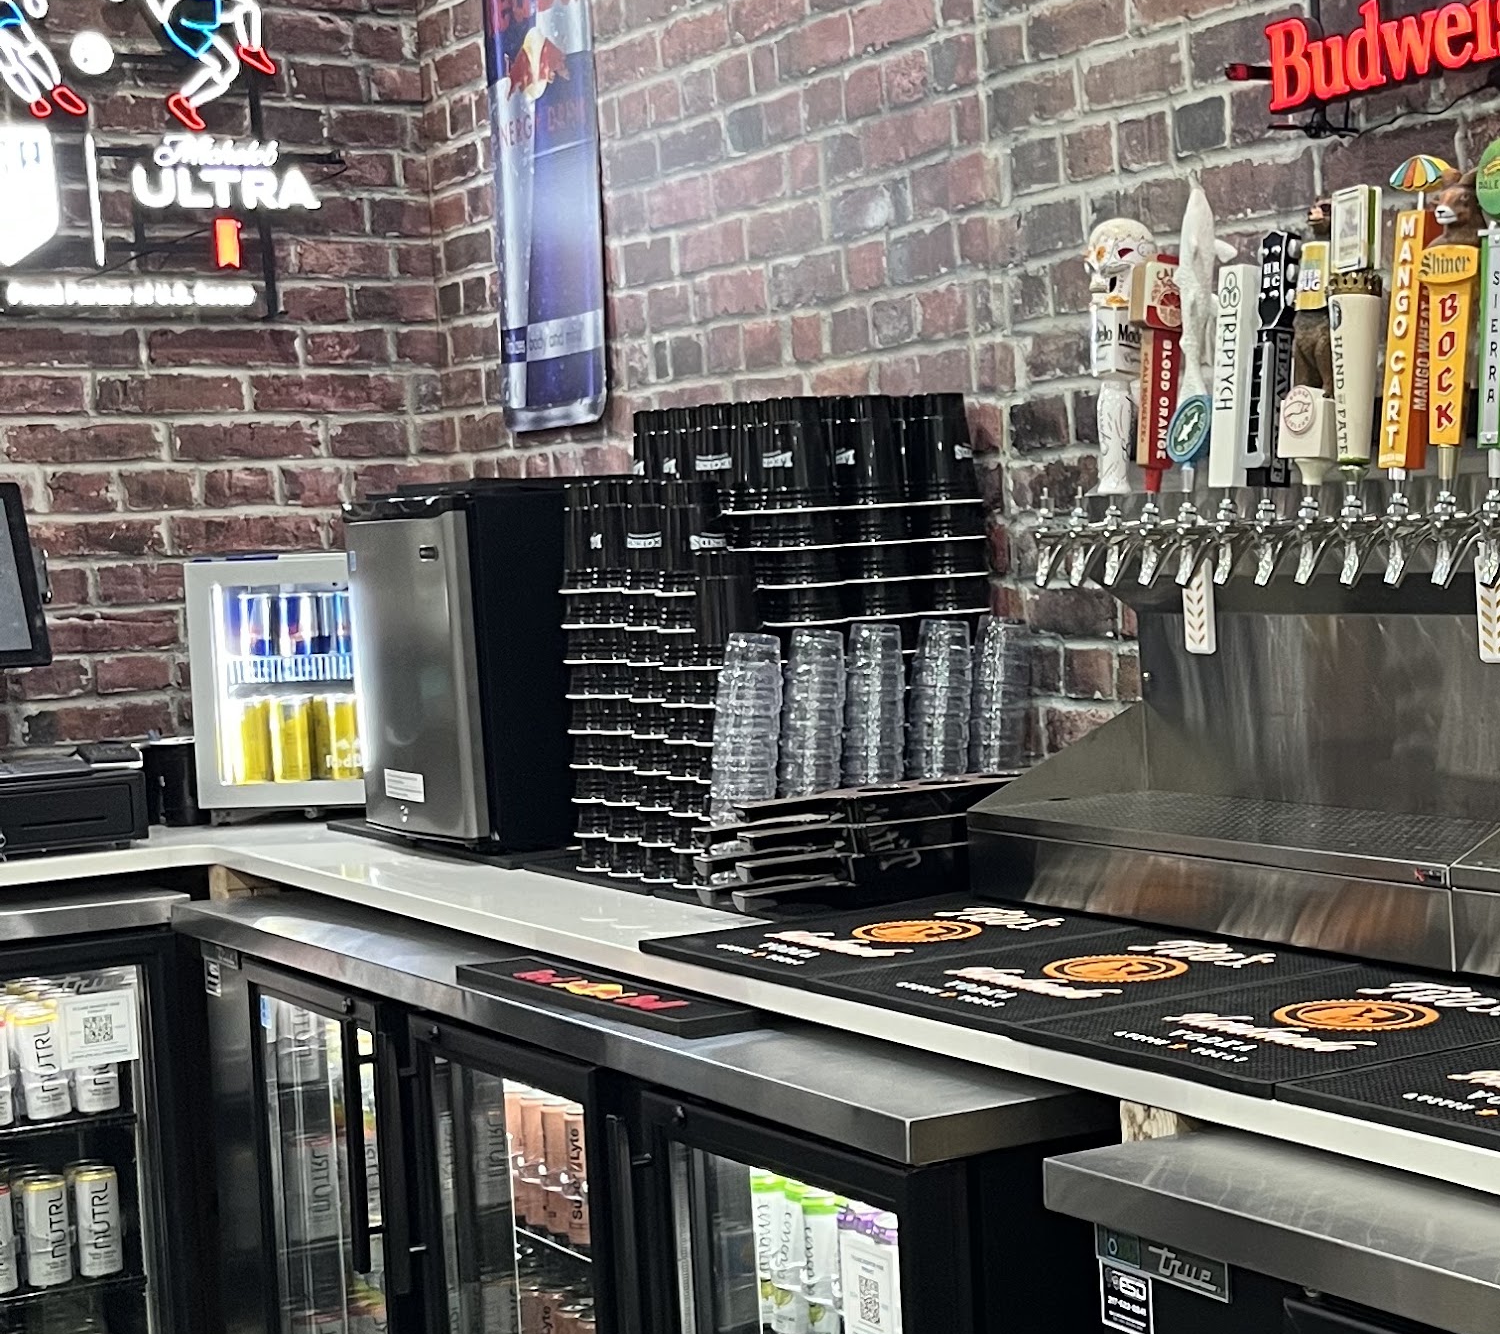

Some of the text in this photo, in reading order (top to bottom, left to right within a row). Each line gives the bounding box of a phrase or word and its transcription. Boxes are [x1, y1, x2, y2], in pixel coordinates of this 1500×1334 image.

[132, 164, 322, 210] ULTRA
[1419, 249, 1472, 277] Shiner
[1215, 309, 1239, 411] TRIPTYCH
[1384, 215, 1416, 447] MANGO CART
[1435, 293, 1460, 431] BOCK
[1485, 270, 1500, 403] SIERRA
[1155, 339, 1173, 460] BLOOD ORANGE
